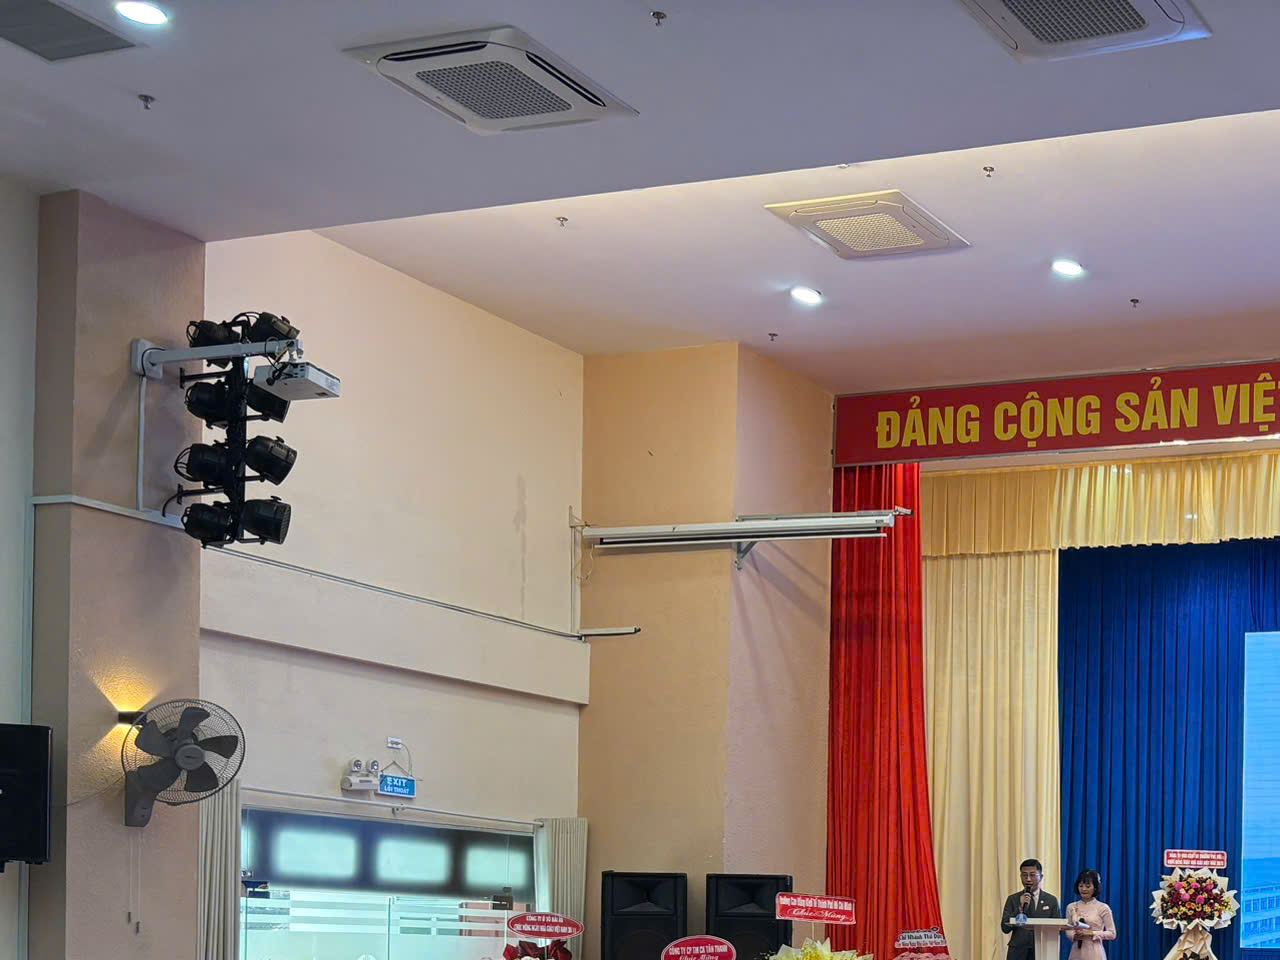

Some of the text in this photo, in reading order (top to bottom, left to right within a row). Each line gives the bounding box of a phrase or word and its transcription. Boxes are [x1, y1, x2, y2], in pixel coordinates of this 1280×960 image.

[876, 396, 980, 449] ĐẢNG
[993, 392, 1101, 448] CỘNG
[1115, 377, 1198, 434] SẢN
[387, 777, 408, 787] EXIT
